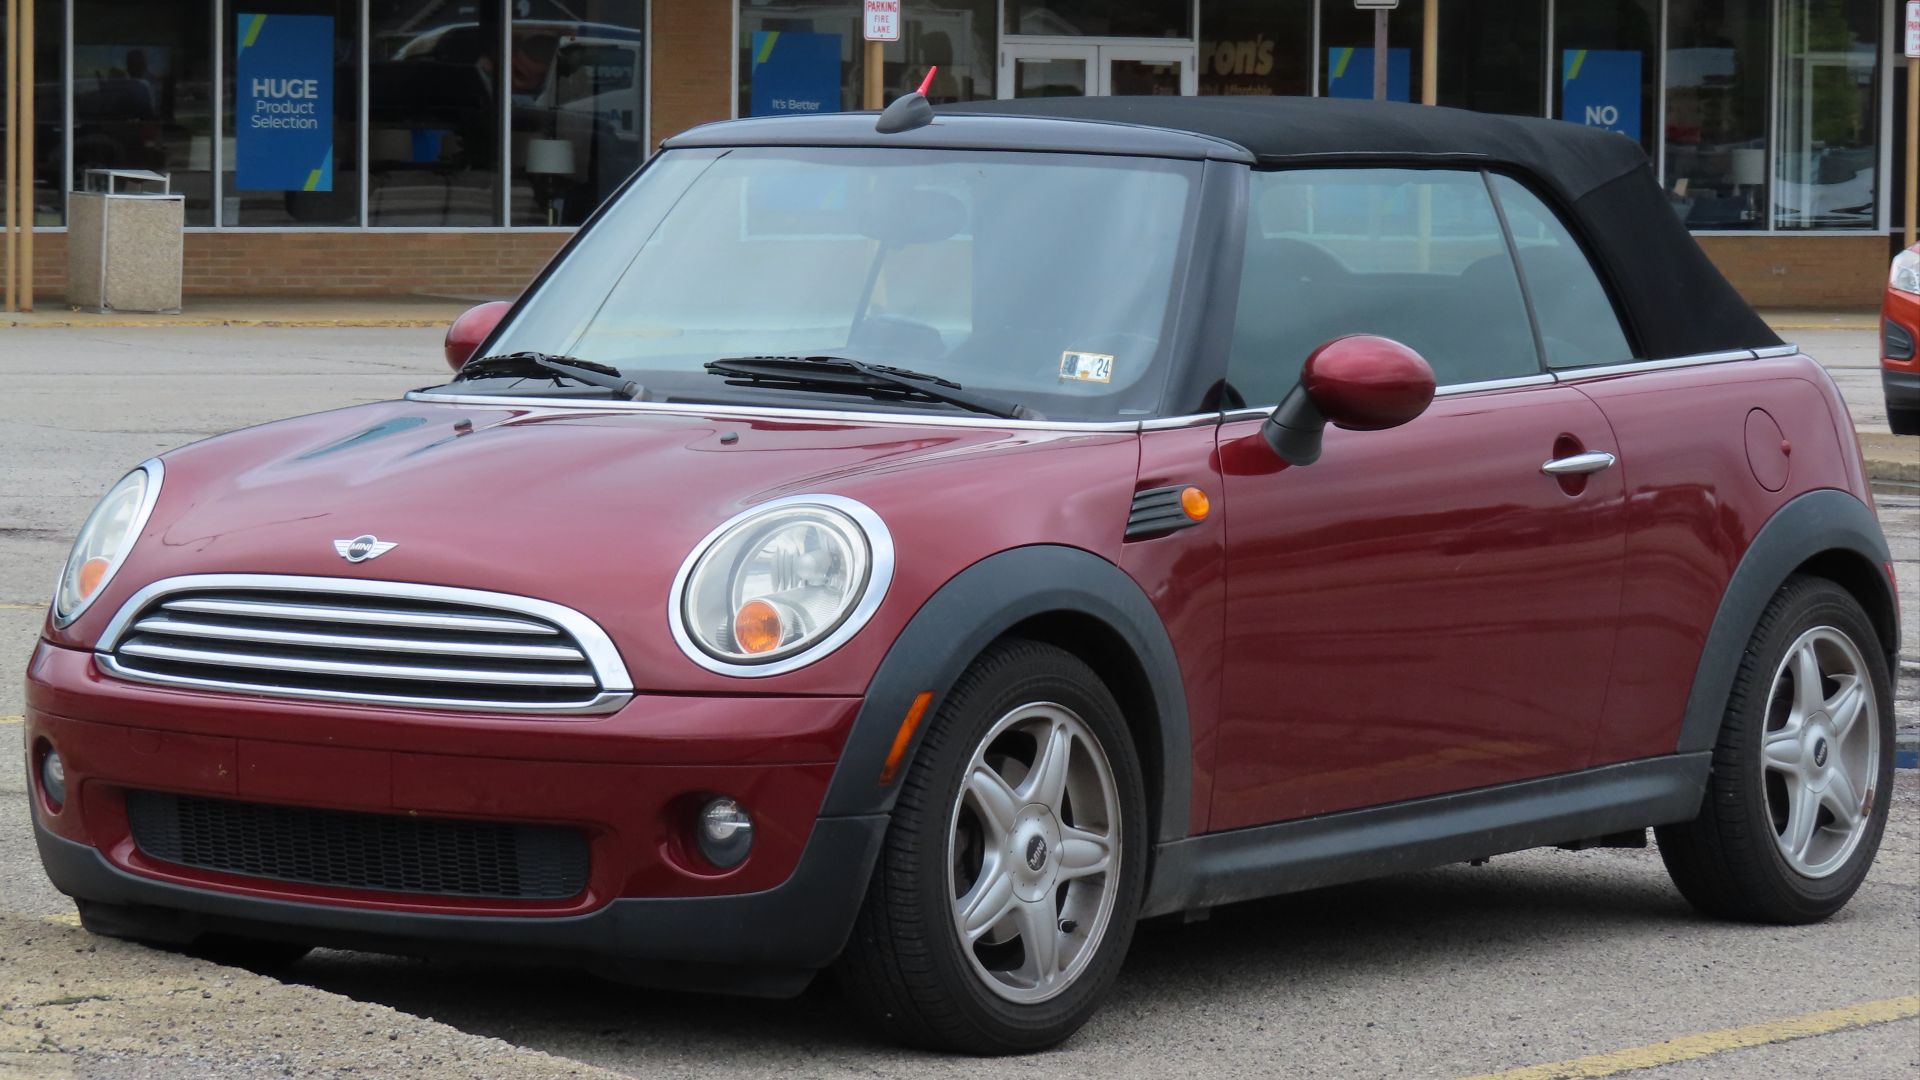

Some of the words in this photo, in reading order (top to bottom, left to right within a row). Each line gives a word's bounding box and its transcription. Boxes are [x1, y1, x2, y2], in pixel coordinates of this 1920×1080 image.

[867, 1, 897, 12] PARKING
[874, 14, 890, 23] FIRE
[873, 25, 891, 33] LANE
[252, 78, 318, 99] HUGE
[256, 100, 315, 114] Product
[772, 99, 786, 110] It's
[788, 99, 820, 111] Better
[251, 114, 318, 129] Selection
[1585, 105, 1618, 126] NO
[1096, 358, 1110, 378] 24
[350, 542, 373, 552] MINI
[1030, 839, 1046, 867] MINI
